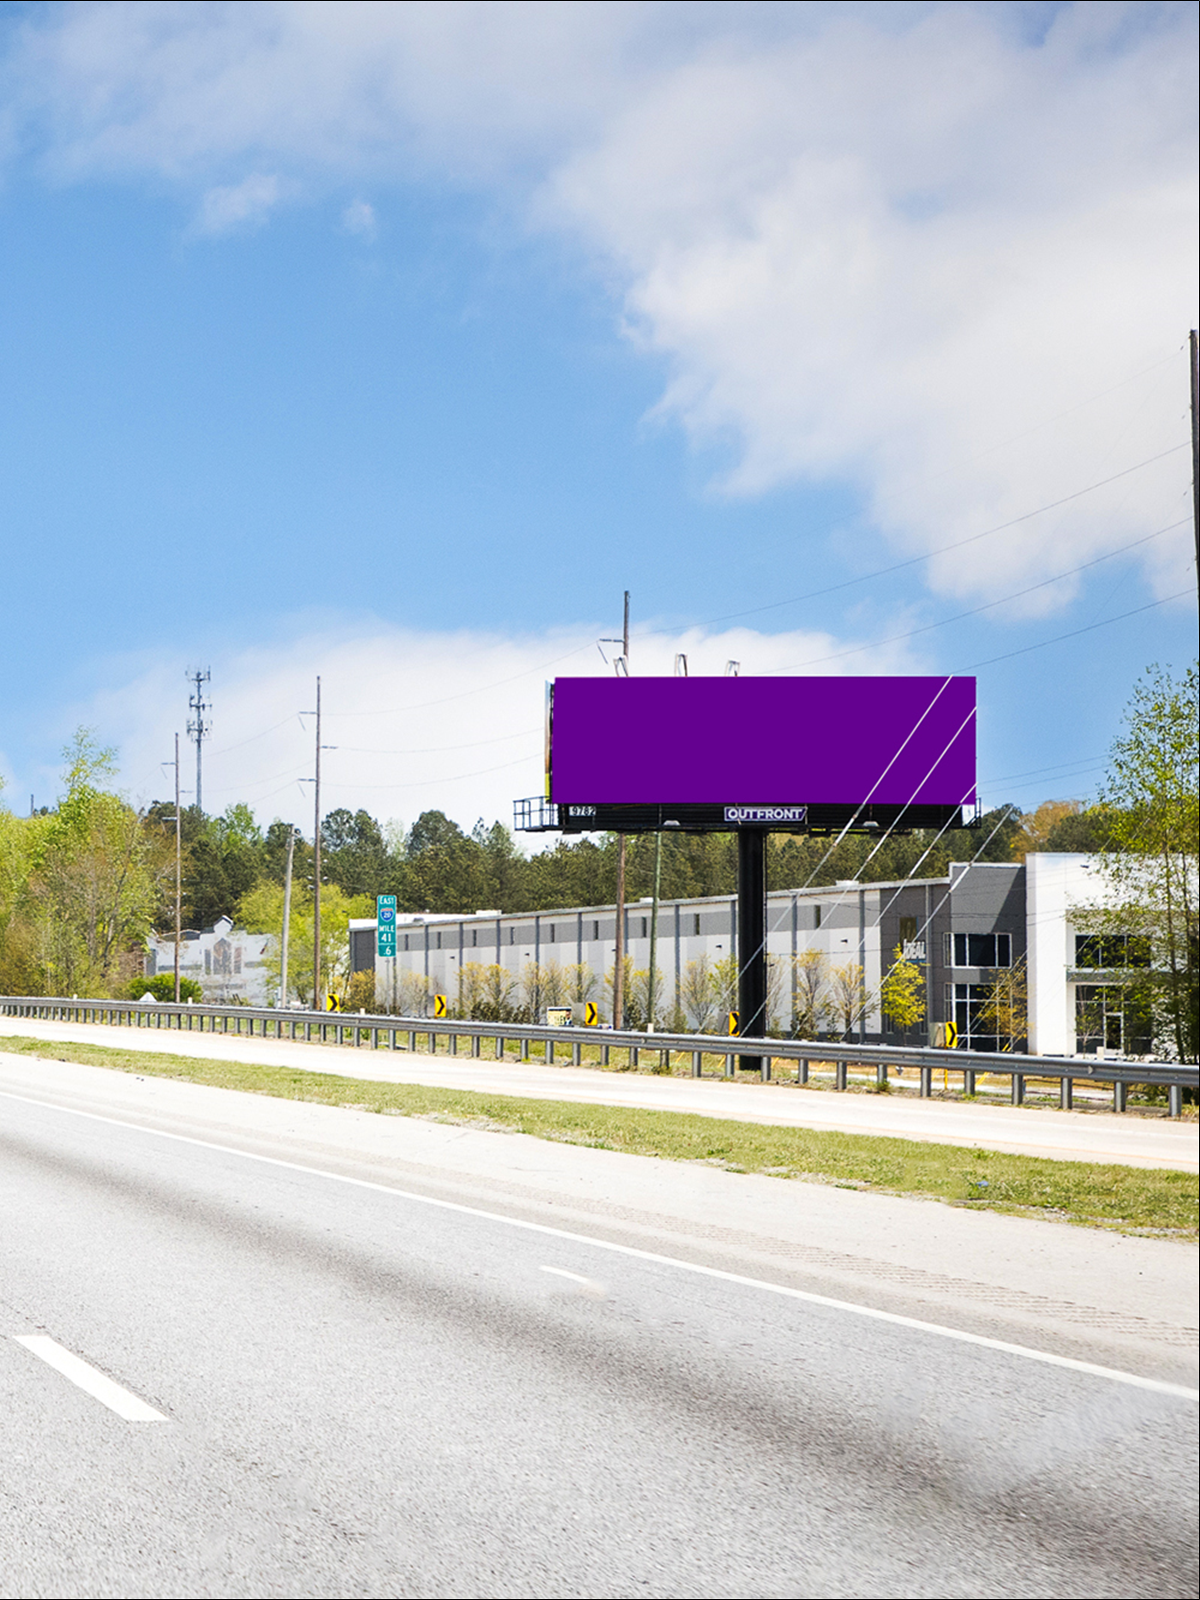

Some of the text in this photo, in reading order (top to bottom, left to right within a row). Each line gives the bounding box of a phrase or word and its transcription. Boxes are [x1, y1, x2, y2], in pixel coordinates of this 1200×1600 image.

[572, 806, 596, 816] 9782
[727, 807, 804, 820] OUTFRONT
[379, 896, 395, 905] EAST
[379, 925, 395, 933] MILE
[381, 933, 392, 942] 41
